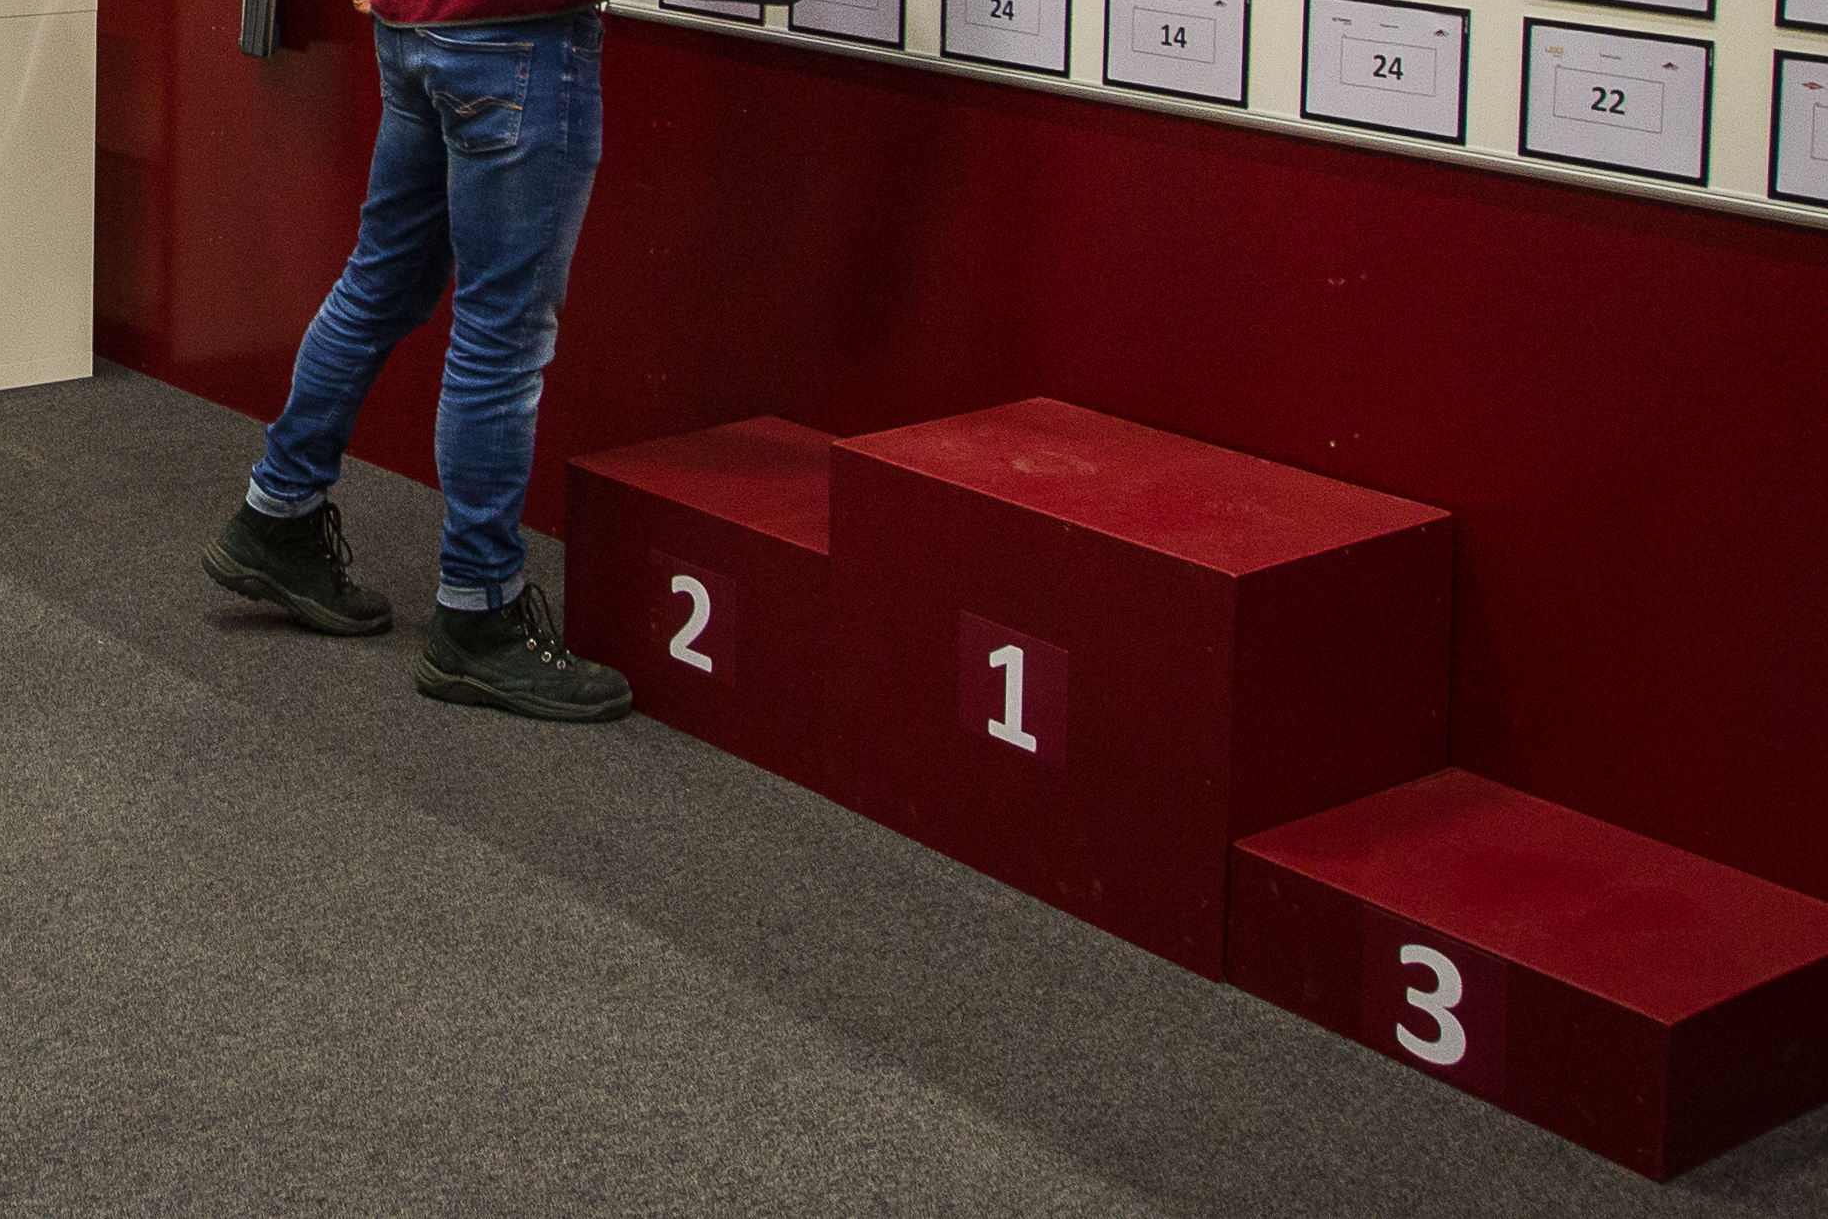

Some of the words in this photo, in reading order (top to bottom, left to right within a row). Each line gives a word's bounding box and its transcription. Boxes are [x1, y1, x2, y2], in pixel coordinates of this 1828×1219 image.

[1160, 24, 1187, 48] 14
[1373, 54, 1404, 81] 24
[1590, 86, 1626, 116] 22
[670, 575, 713, 673] 2
[988, 644, 1037, 753] 1
[1396, 944, 1466, 1065] 3
